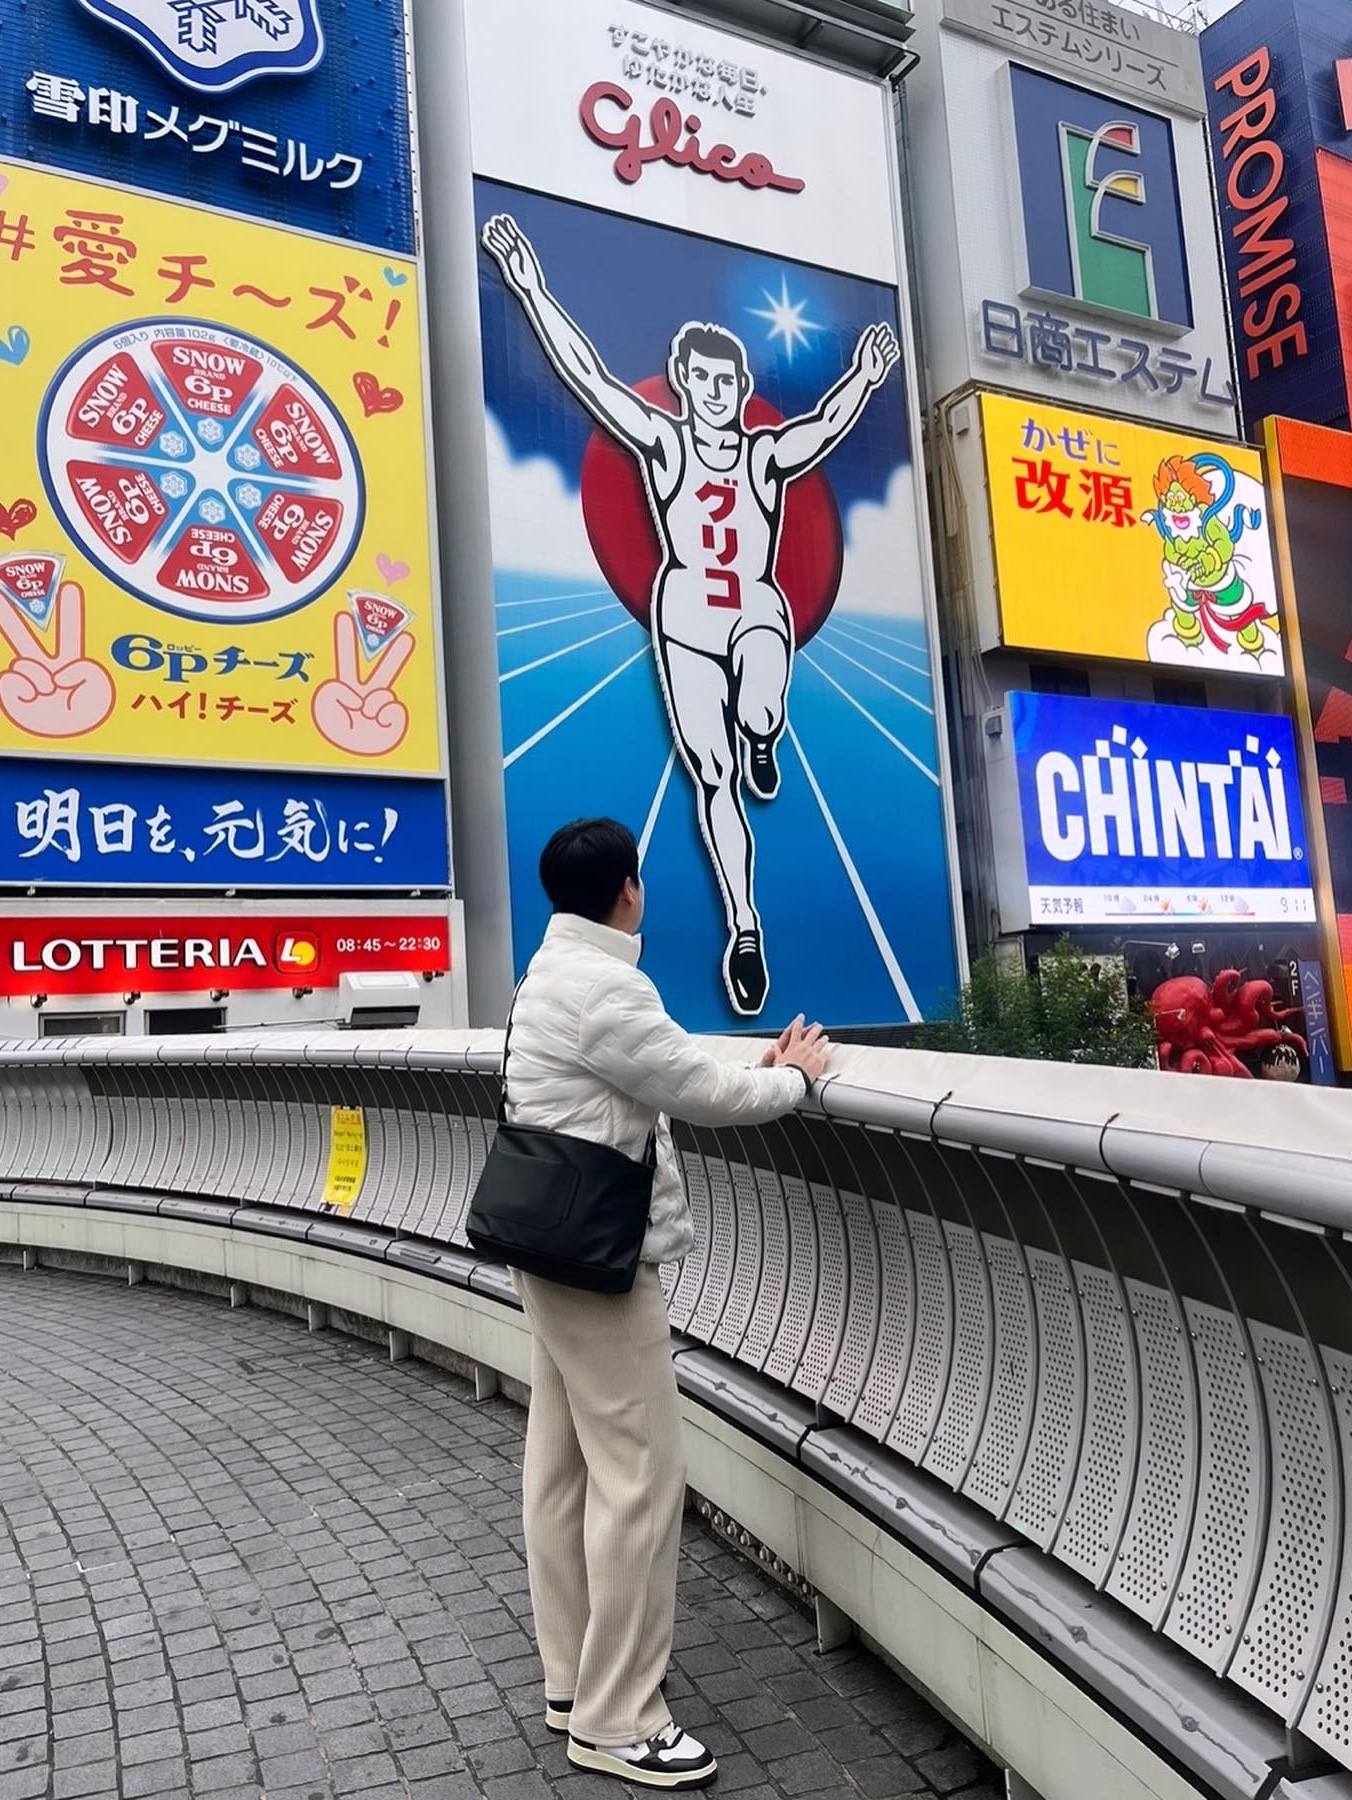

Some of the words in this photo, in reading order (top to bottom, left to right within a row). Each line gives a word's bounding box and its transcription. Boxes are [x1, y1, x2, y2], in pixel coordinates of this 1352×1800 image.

[992, 4, 1167, 92] エステムシリーズ
[622, 53, 756, 119] ゆたかな人生
[26, 71, 363, 189] 雪印メグミルク
[579, 80, 806, 194] Glico
[1213, 46, 1308, 381] PROMISE
[172, 346, 247, 376] SNOW
[981, 299, 1238, 407] 日商エステム
[184, 375, 234, 402] 6P
[193, 368, 228, 381] BRAND
[78, 363, 129, 428] SNOW
[106, 392, 128, 419] BRAND
[187, 398, 233, 415] CHEESE
[112, 397, 149, 436] 6P
[134, 409, 165, 447] CHEESE
[284, 401, 336, 465] SNOW
[255, 428, 285, 469] CHEESE
[270, 419, 299, 464] 6P
[288, 423, 308, 454] BRAND
[1021, 417, 1121, 467] かぜに
[75, 477, 133, 546] SNOW
[106, 490, 130, 521] BRAND
[117, 478, 150, 525] 6P
[134, 472, 165, 516] CHEESE
[1012, 456, 1138, 529] 改源
[257, 493, 286, 531] CHEESE
[272, 503, 306, 541] 6P
[190, 527, 236, 544] CHEESE
[290, 509, 334, 573] SNOW
[291, 518, 311, 546] BRAND
[694, 477, 742, 611] グリコ
[5, 561, 46, 577] SNOW
[189, 540, 239, 567] 6P
[196, 562, 230, 574] BRAND
[175, 568, 250, 595] SNOW
[363, 599, 398, 619] SNOW
[1036, 724, 1294, 862] CHINTAI
[1040, 897, 1084, 915] 天気予報
[12, 936, 268, 973] LOTTERIA
